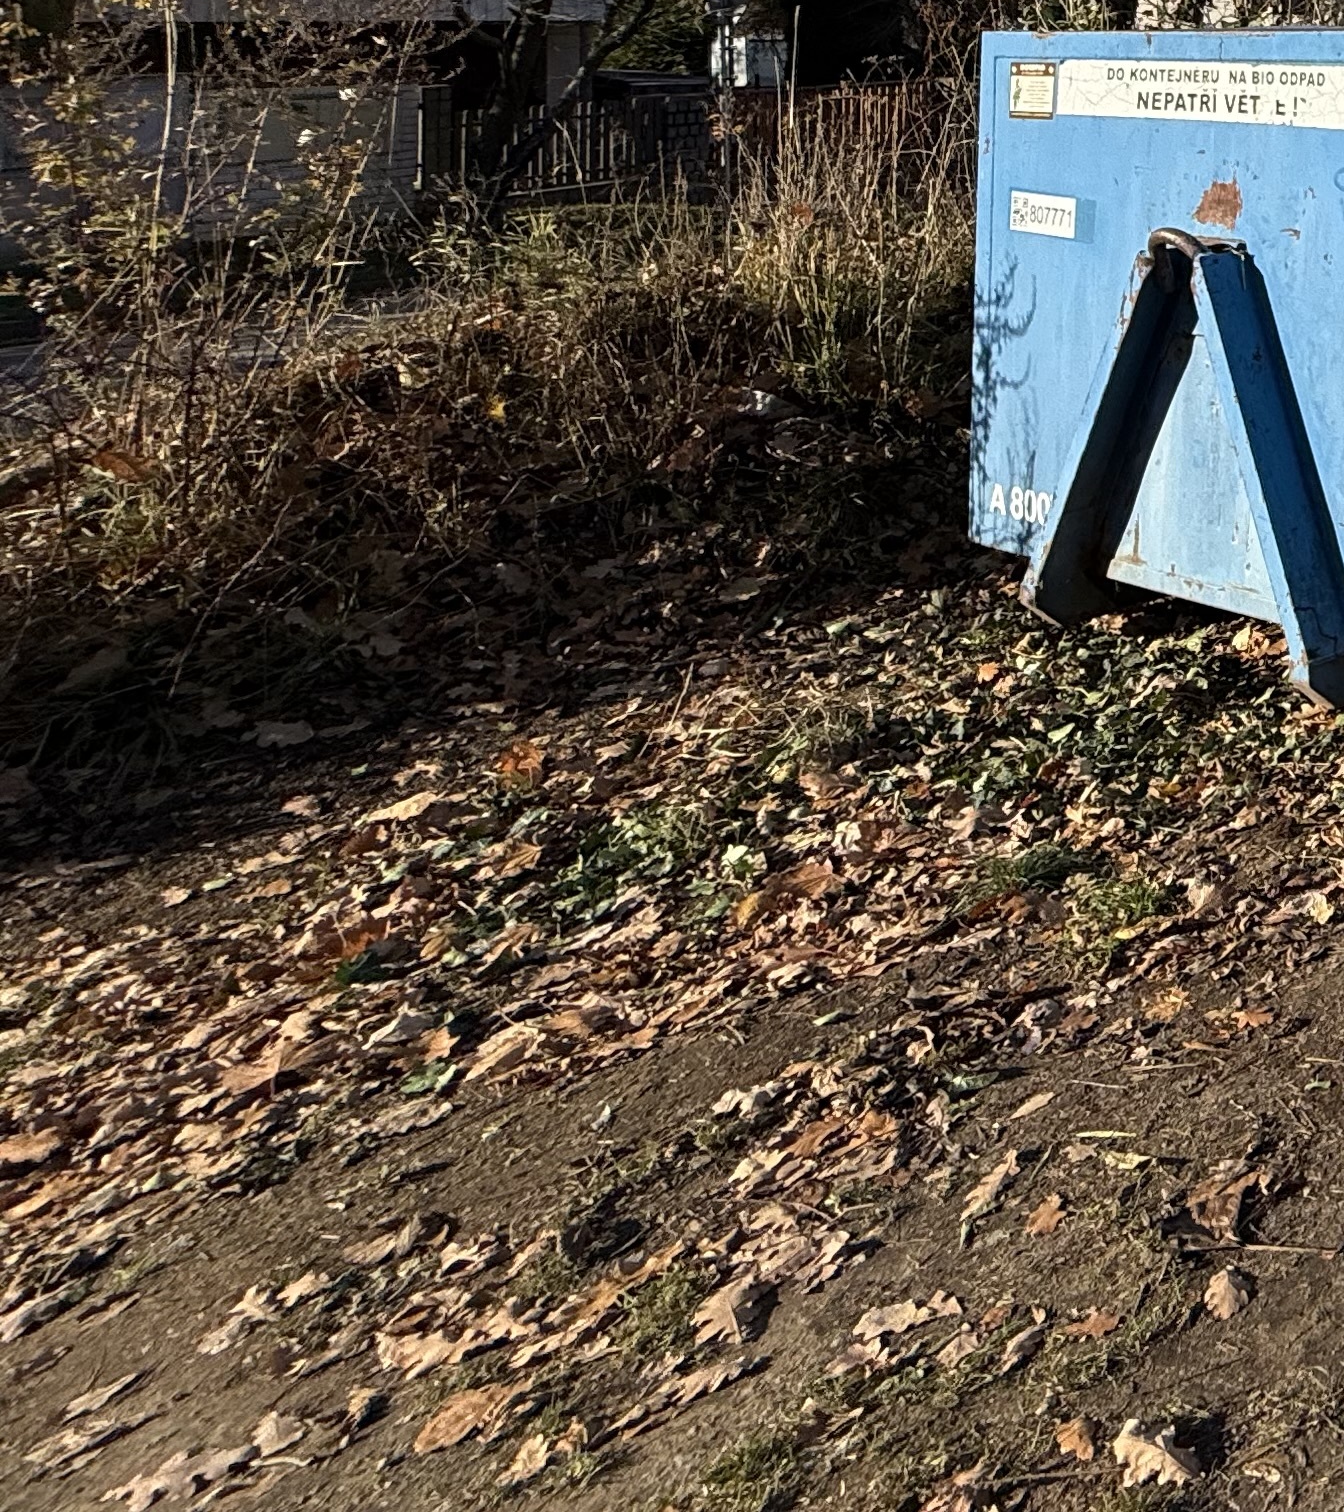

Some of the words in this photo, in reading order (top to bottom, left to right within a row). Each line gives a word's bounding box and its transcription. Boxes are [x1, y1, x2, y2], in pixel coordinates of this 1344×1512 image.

[1107, 67, 1125, 81] DO
[1229, 70, 1247, 84] NA
[1252, 71, 1275, 85] BIO
[1279, 72, 1326, 86] ODPAD
[1030, 204, 1072, 228] 807771
[989, 483, 1007, 516] A
